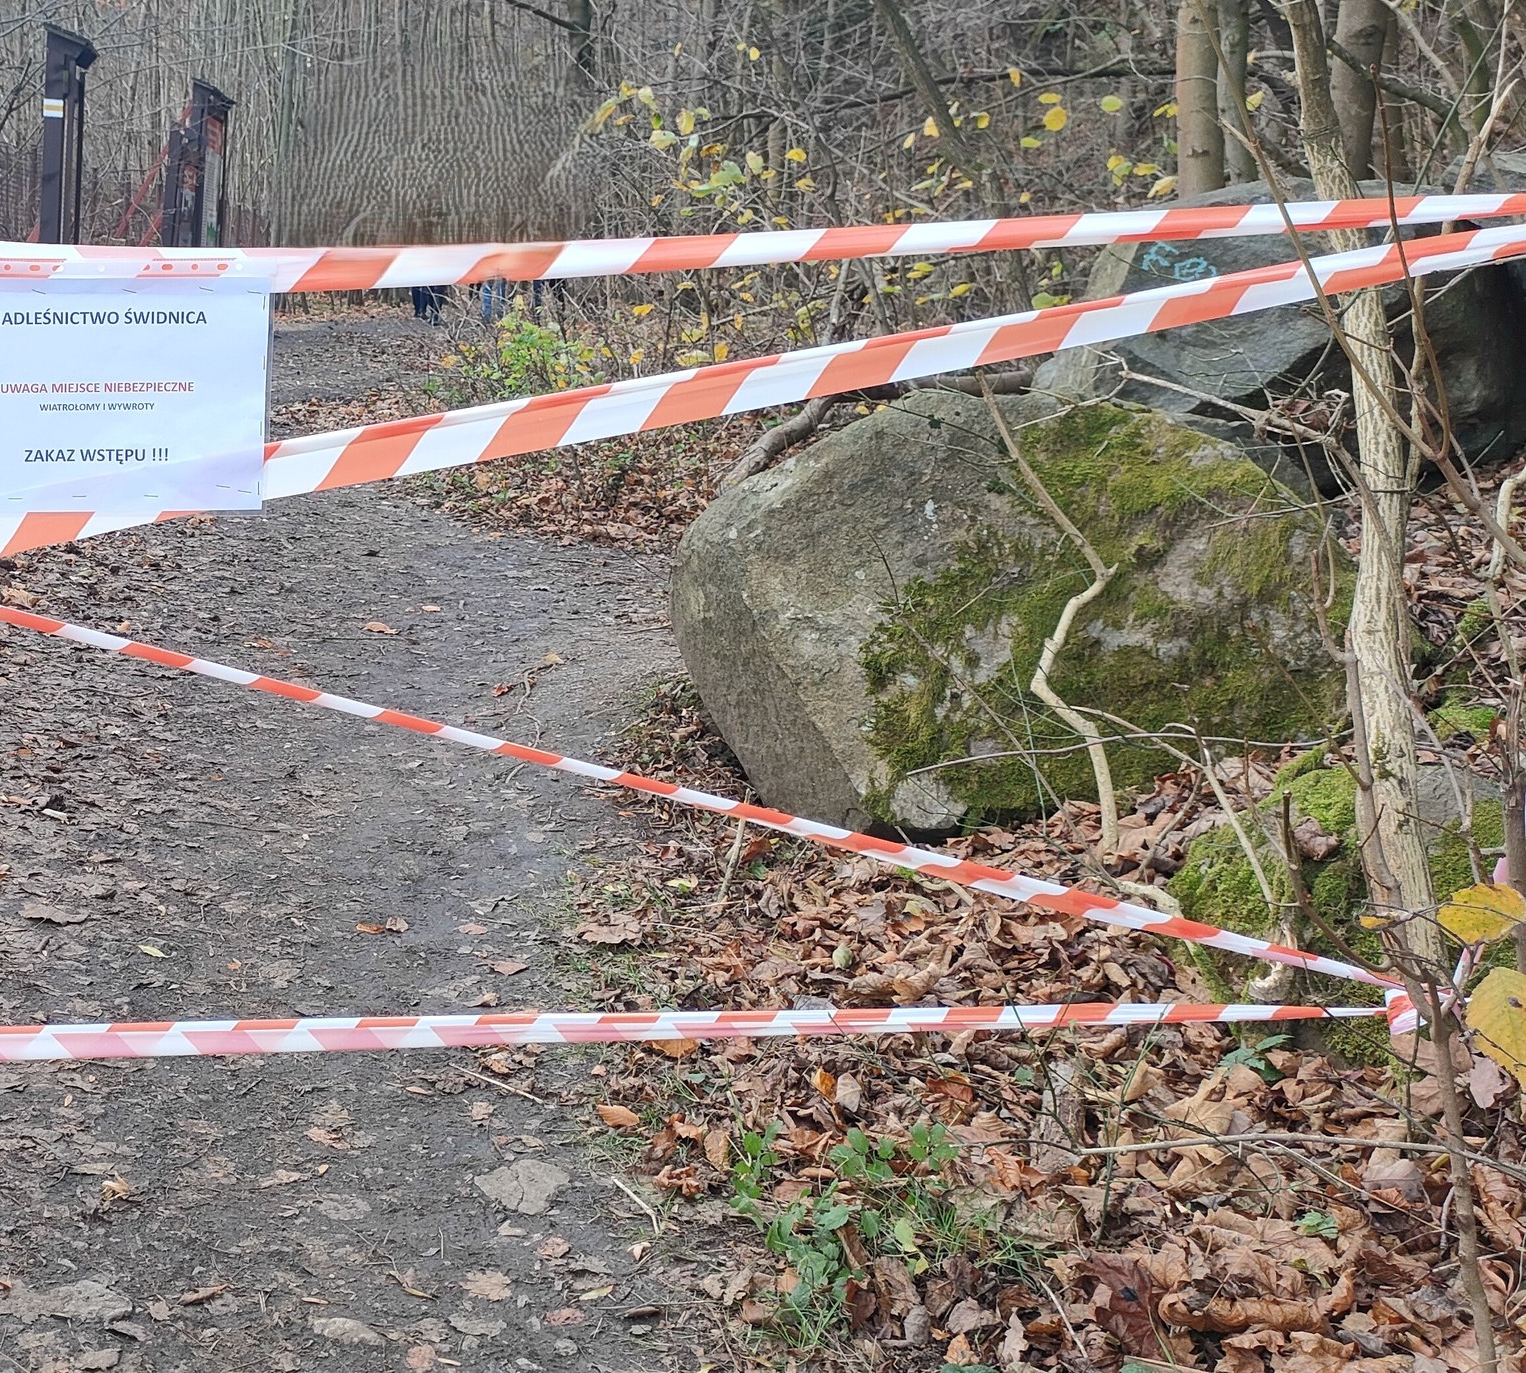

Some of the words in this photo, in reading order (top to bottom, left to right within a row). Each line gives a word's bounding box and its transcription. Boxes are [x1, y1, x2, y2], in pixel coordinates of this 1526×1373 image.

[124, 307, 208, 325] ŚWIDNICA
[0, 383, 48, 394] UWAGA
[51, 382, 101, 394] MIEJSCE
[104, 381, 195, 393] NIEBEZPIECZNE
[39, 402, 101, 412] WIATROŁOMY
[108, 402, 155, 411] WYWROTY
[24, 449, 76, 463] ZAKAZ
[80, 448, 146, 466] WSTĘPU
[152, 448, 169, 462] !!!
